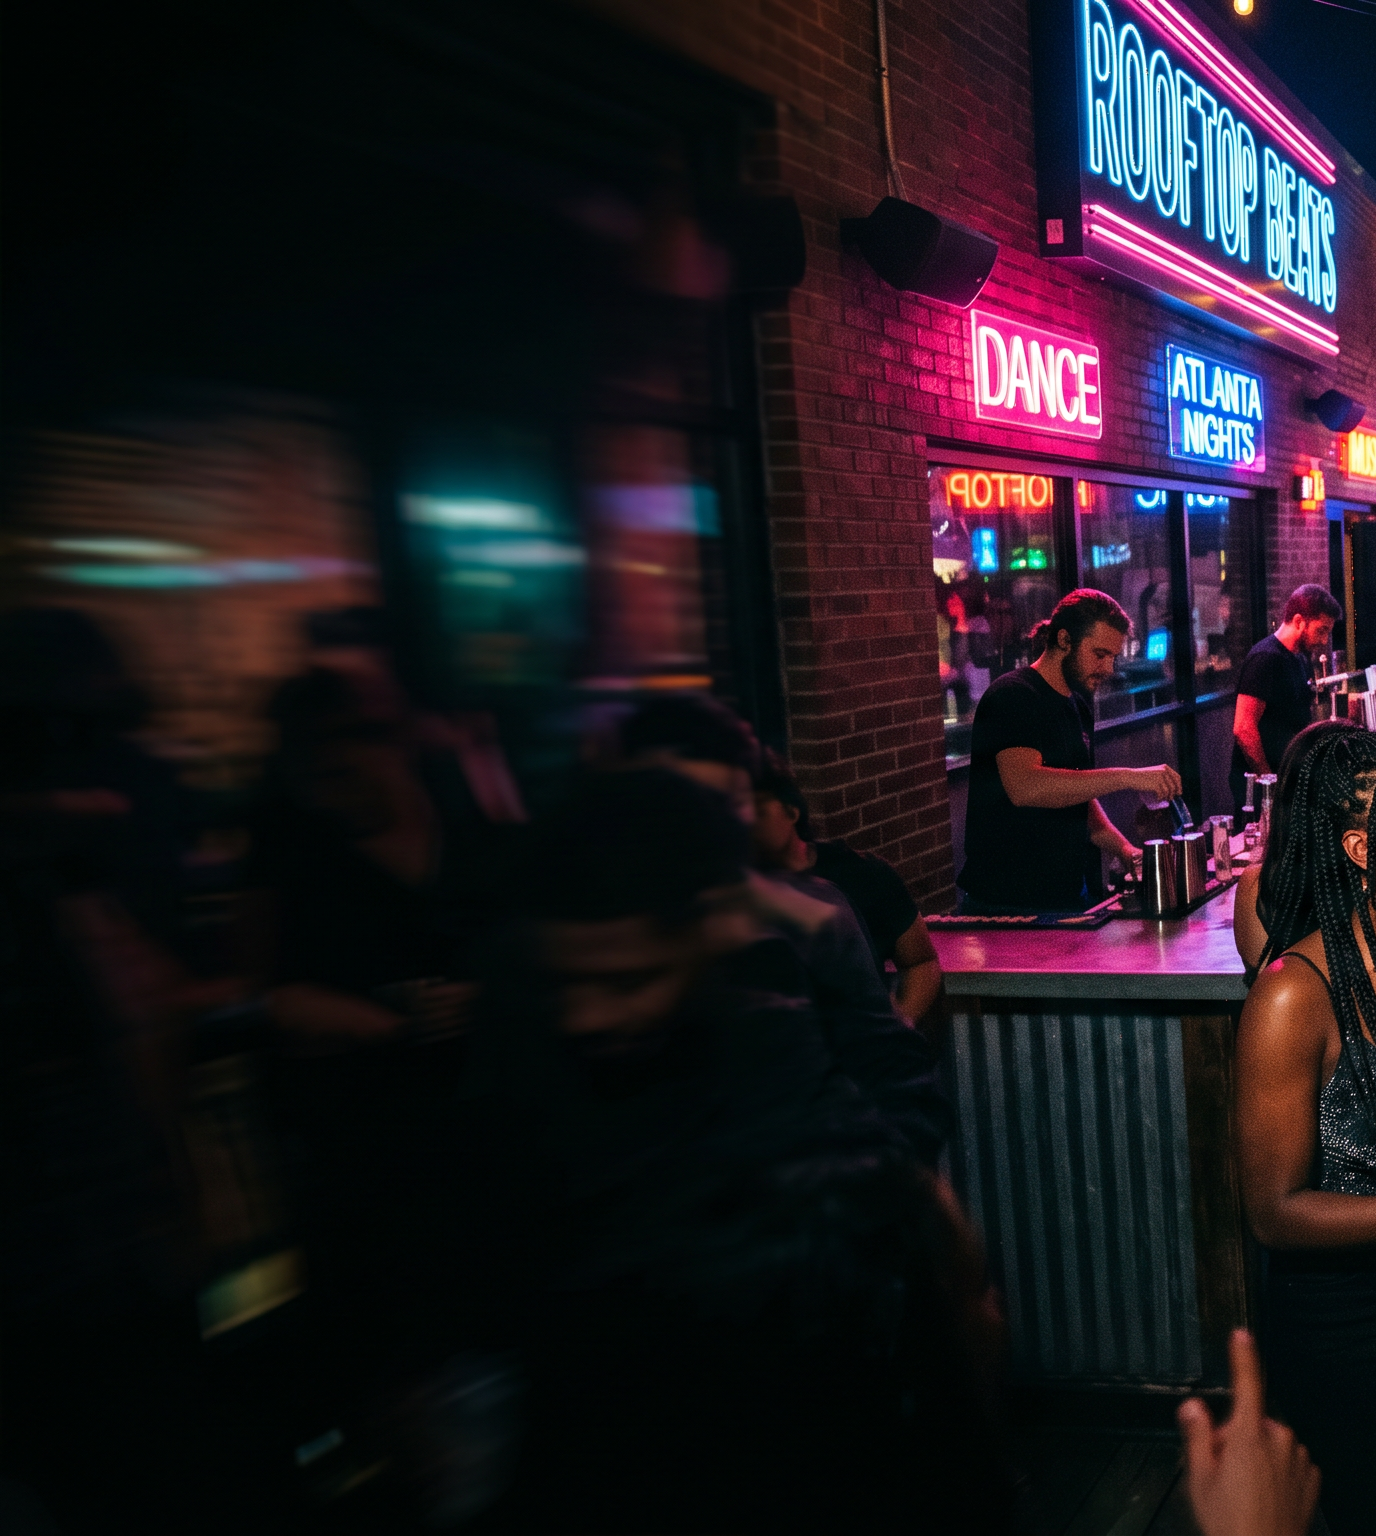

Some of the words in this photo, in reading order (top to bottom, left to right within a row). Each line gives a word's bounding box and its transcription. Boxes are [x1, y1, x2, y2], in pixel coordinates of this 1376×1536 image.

[1083, 0, 1258, 263] ROOFTOP
[1264, 147, 1337, 313] BEATS
[977, 325, 1100, 425] DANCE
[1171, 353, 1263, 421] ATLANTA
[1180, 408, 1256, 465] NIGHTS
